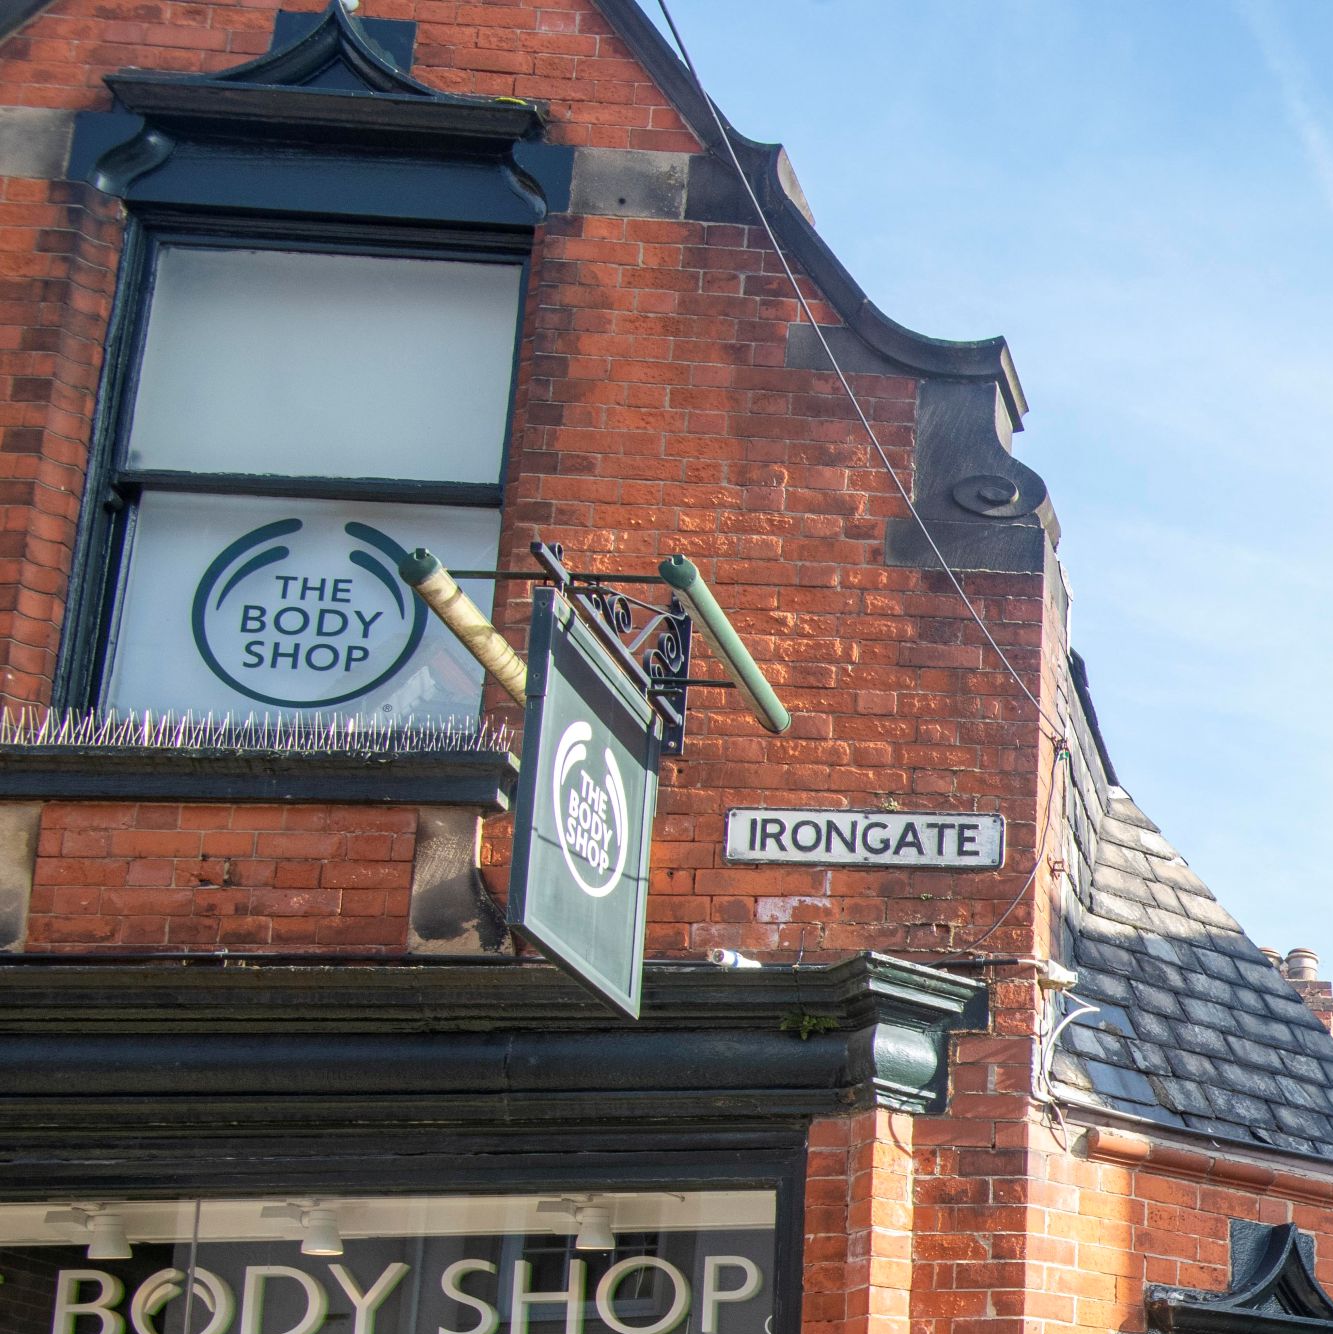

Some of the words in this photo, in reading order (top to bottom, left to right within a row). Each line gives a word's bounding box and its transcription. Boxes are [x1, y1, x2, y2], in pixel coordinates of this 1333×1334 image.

[275, 575, 353, 603] THE
[240, 604, 383, 639] BODY
[242, 640, 370, 672] SHOP
[581, 769, 608, 820] THE
[569, 788, 613, 852] BODY
[749, 817, 981, 857] IRONGATE
[566, 816, 609, 875] SHOP
